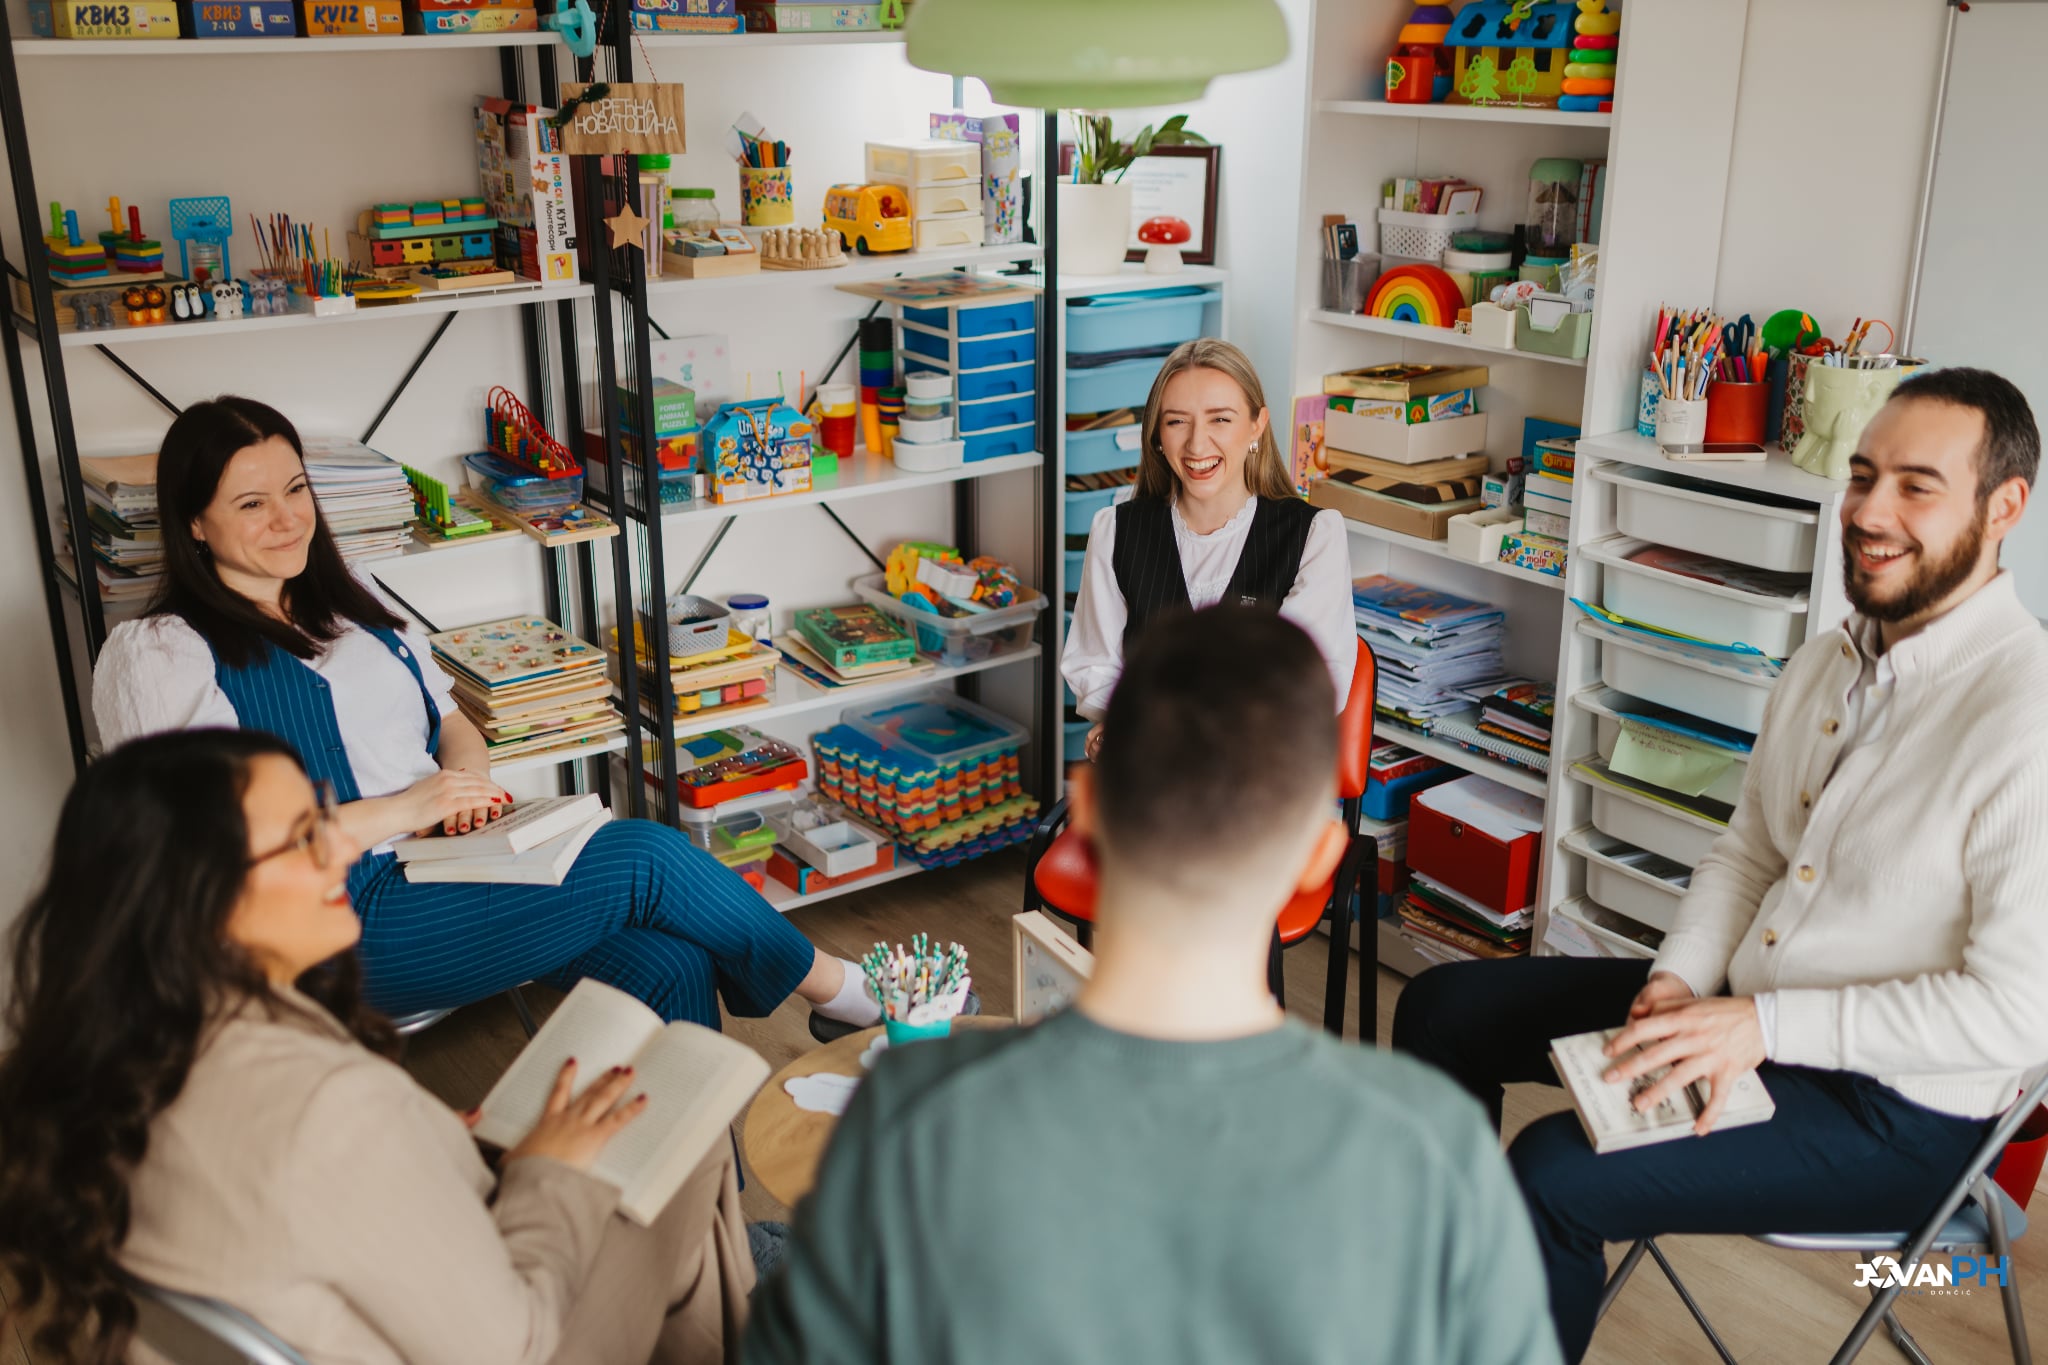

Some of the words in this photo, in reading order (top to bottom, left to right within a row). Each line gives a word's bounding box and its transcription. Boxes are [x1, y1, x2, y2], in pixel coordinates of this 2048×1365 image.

[75, 5, 131, 26] КВИЗ
[202, 5, 242, 20] КВИЗ
[313, 5, 359, 24] KVIZ
[211, 21, 236, 31] 7-10
[545, 200, 556, 251] Монтесори
[659, 402, 685, 411] FOREST
[658, 411, 690, 421] ANIMALS
[662, 419, 688, 430] PUZZLE
